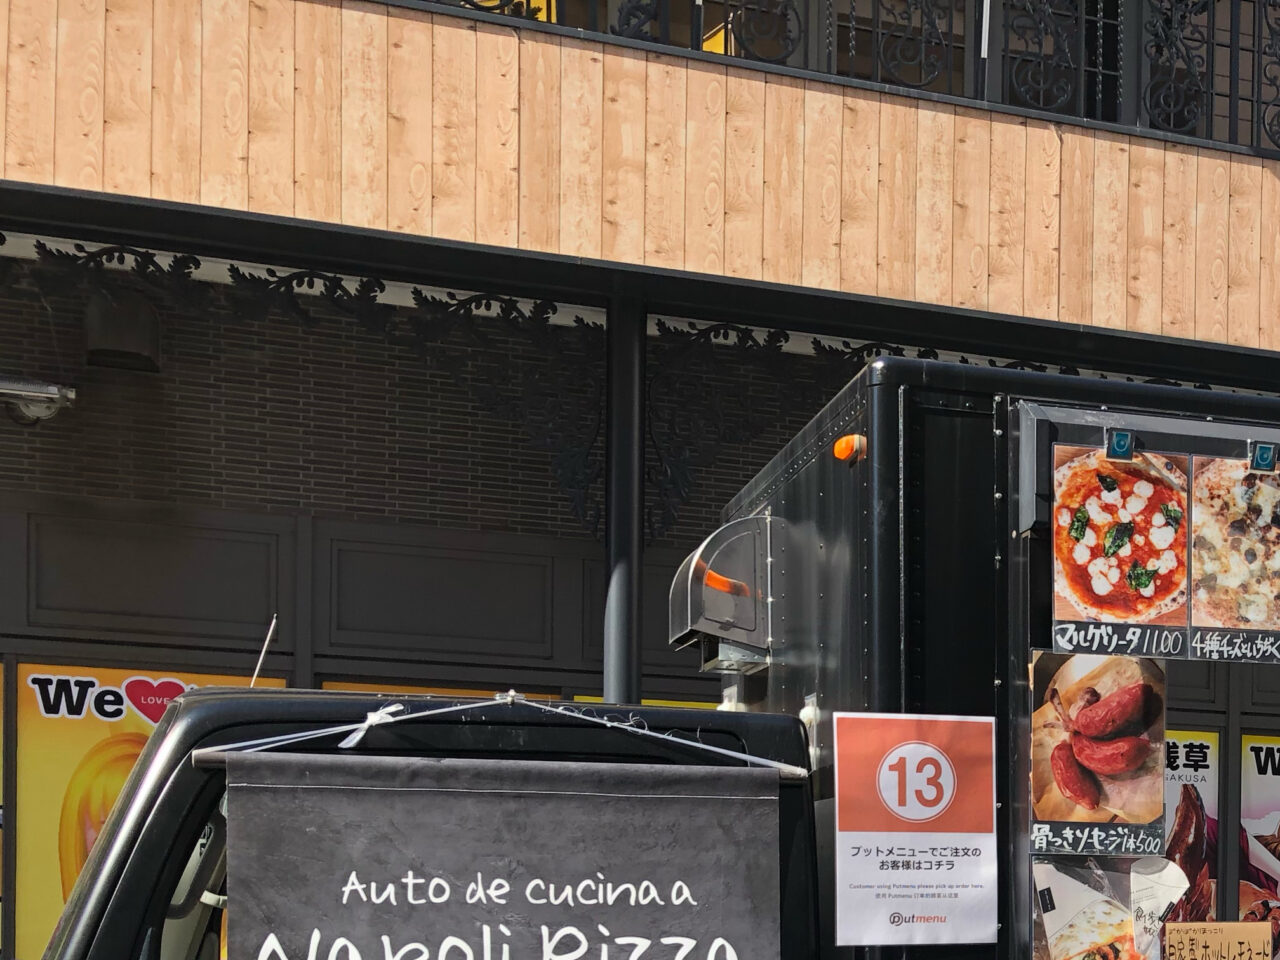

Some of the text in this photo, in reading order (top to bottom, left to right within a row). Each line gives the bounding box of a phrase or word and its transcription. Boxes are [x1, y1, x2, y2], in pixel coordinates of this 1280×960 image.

[31, 677, 124, 718] We
[141, 696, 171, 706] LOVE
[888, 756, 945, 808] 13
[1166, 773, 1207, 783] AKUSA
[878, 860, 956, 872] お客様はコチラ
[342, 870, 698, 907] Auto de cucina a
